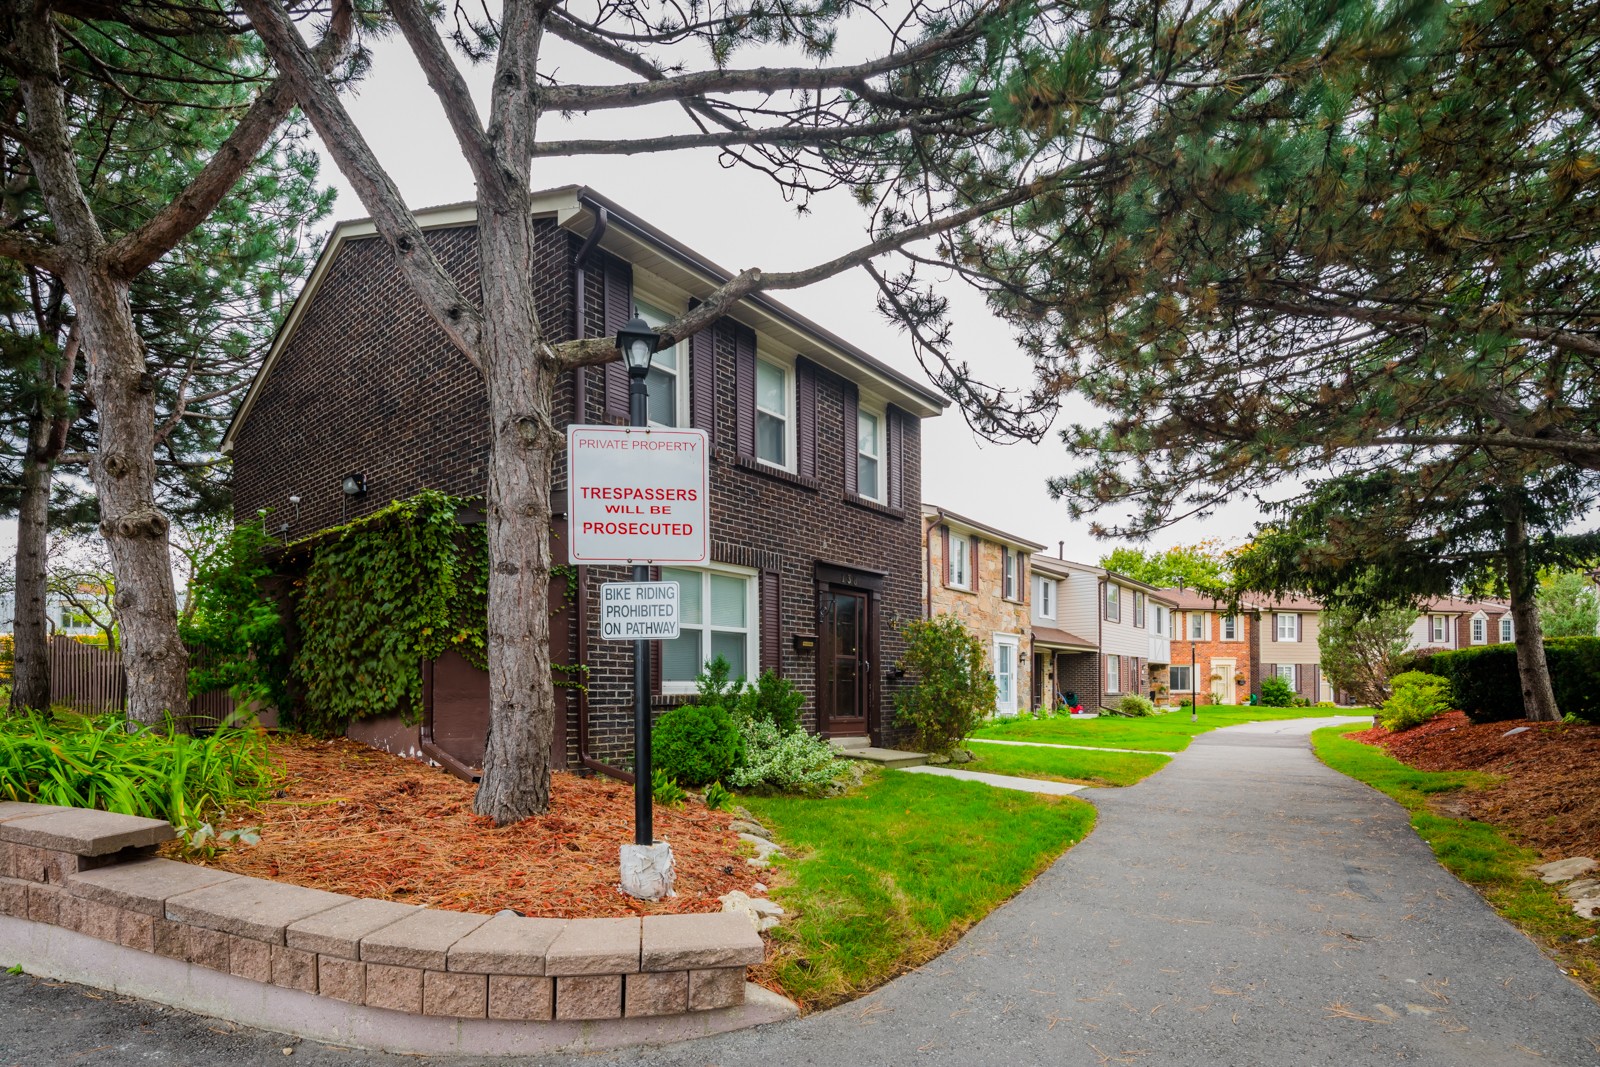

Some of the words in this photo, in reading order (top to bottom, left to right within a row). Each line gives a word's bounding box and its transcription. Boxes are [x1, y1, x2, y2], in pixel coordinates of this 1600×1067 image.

[579, 438, 628, 450] PRIVATE
[632, 440, 697, 451] PROPERTY
[580, 487, 697, 501] TRESPASSERS
[605, 505, 644, 514] WILL
[650, 505, 672, 515] BE
[583, 522, 693, 536] PROSECUTED
[605, 588, 631, 600] BIKE
[636, 587, 675, 600] RIDING
[606, 604, 674, 618] PROHIBITED
[604, 622, 621, 635] ON
[626, 621, 676, 635] PATHWAY
